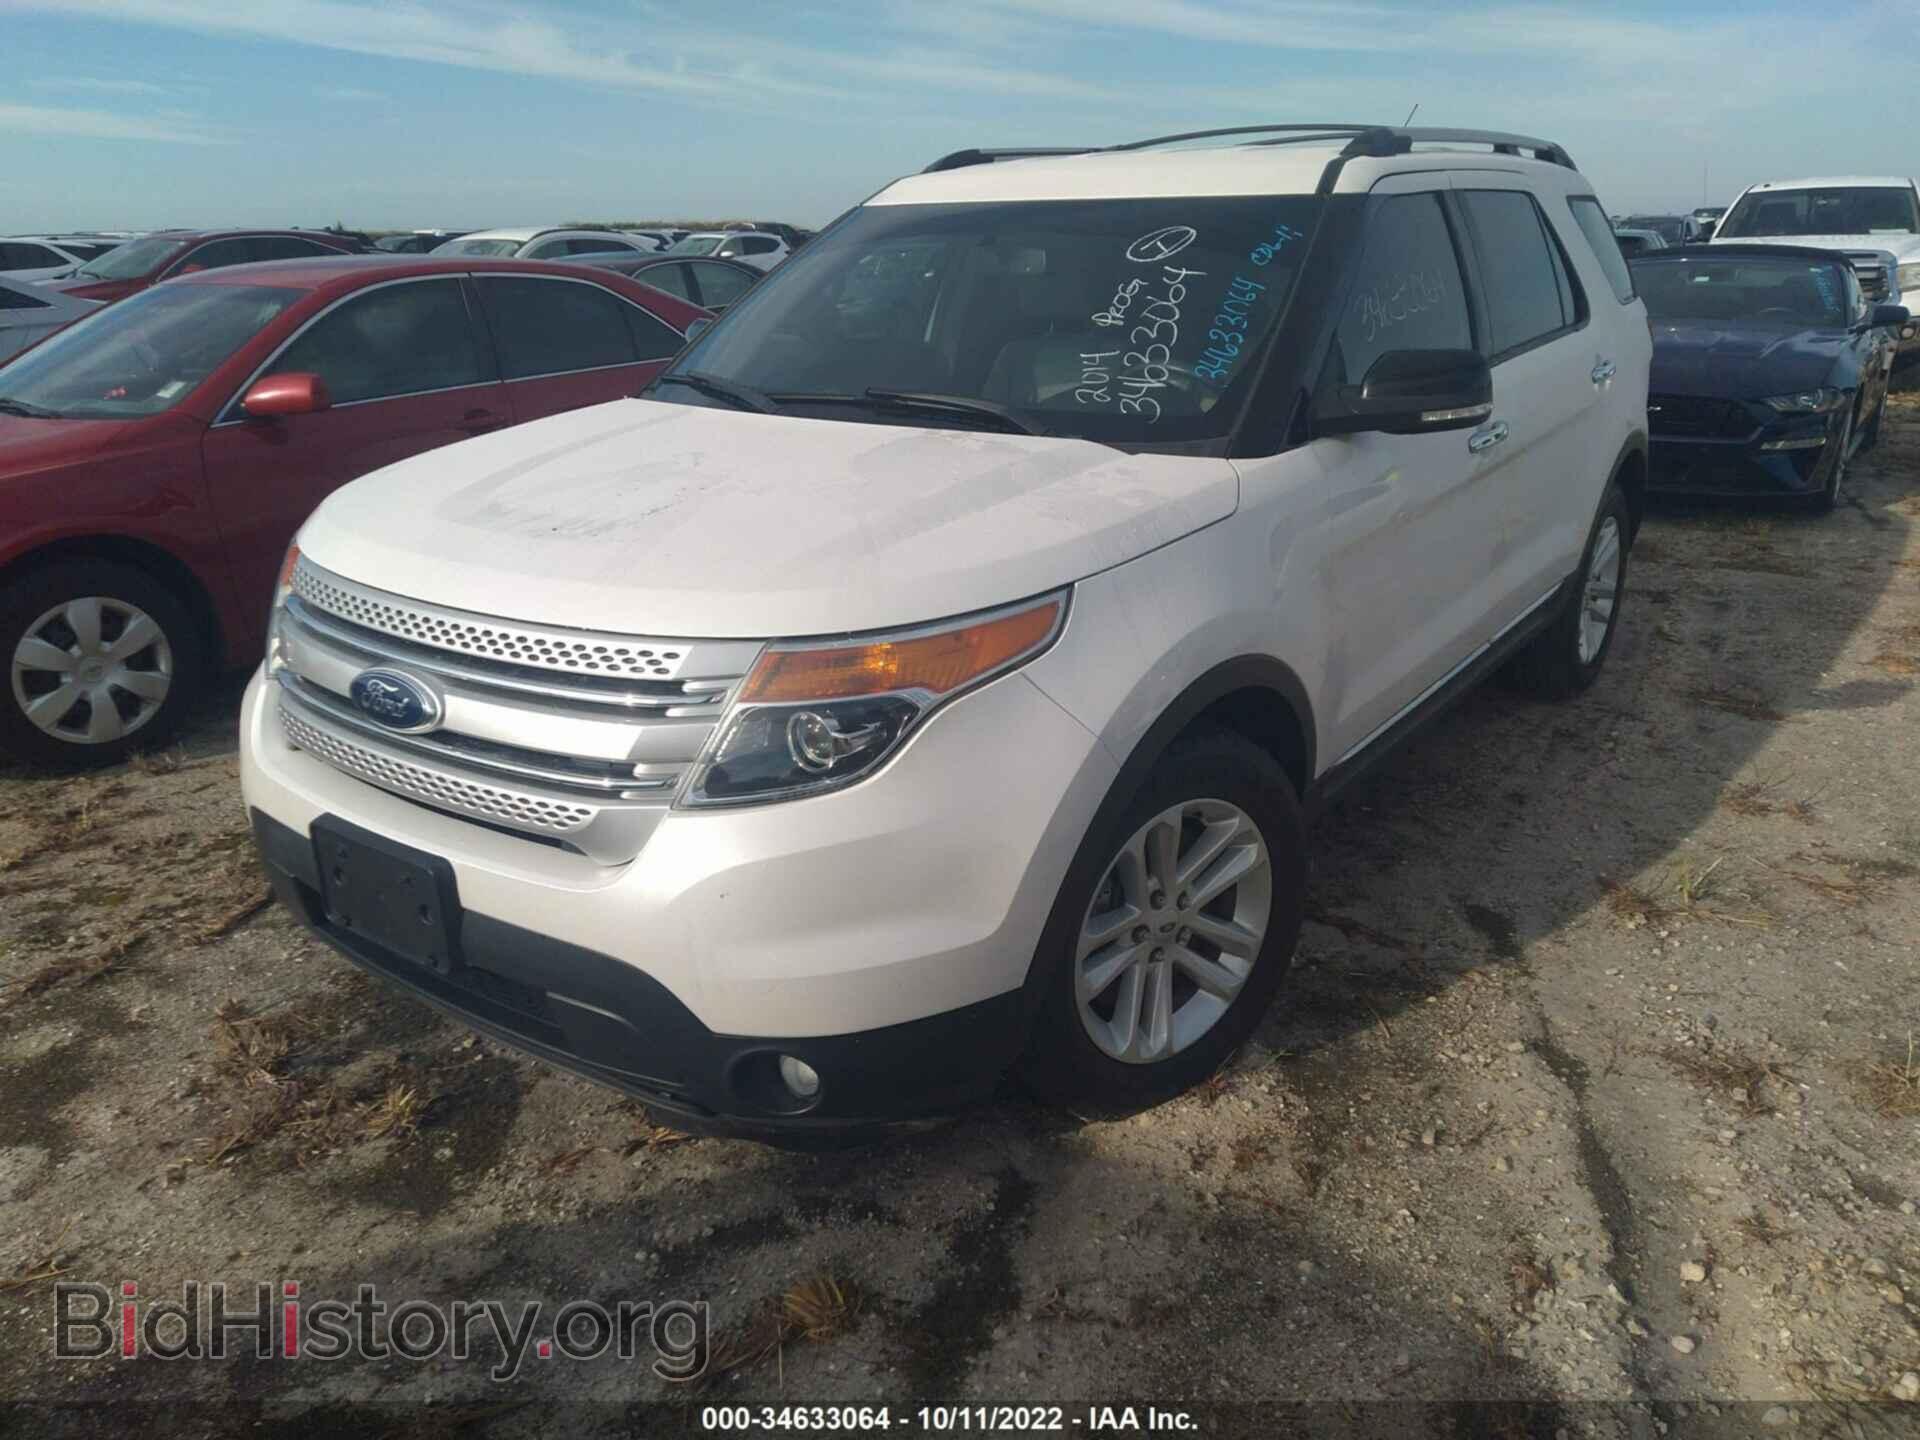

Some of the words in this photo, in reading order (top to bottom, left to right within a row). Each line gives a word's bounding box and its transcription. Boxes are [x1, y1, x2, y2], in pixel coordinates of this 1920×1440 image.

[1116, 265, 1208, 424] 34633064
[1193, 276, 1266, 380] 34633064
[1074, 350, 1121, 404] 2014
[361, 678, 409, 719] Ford
